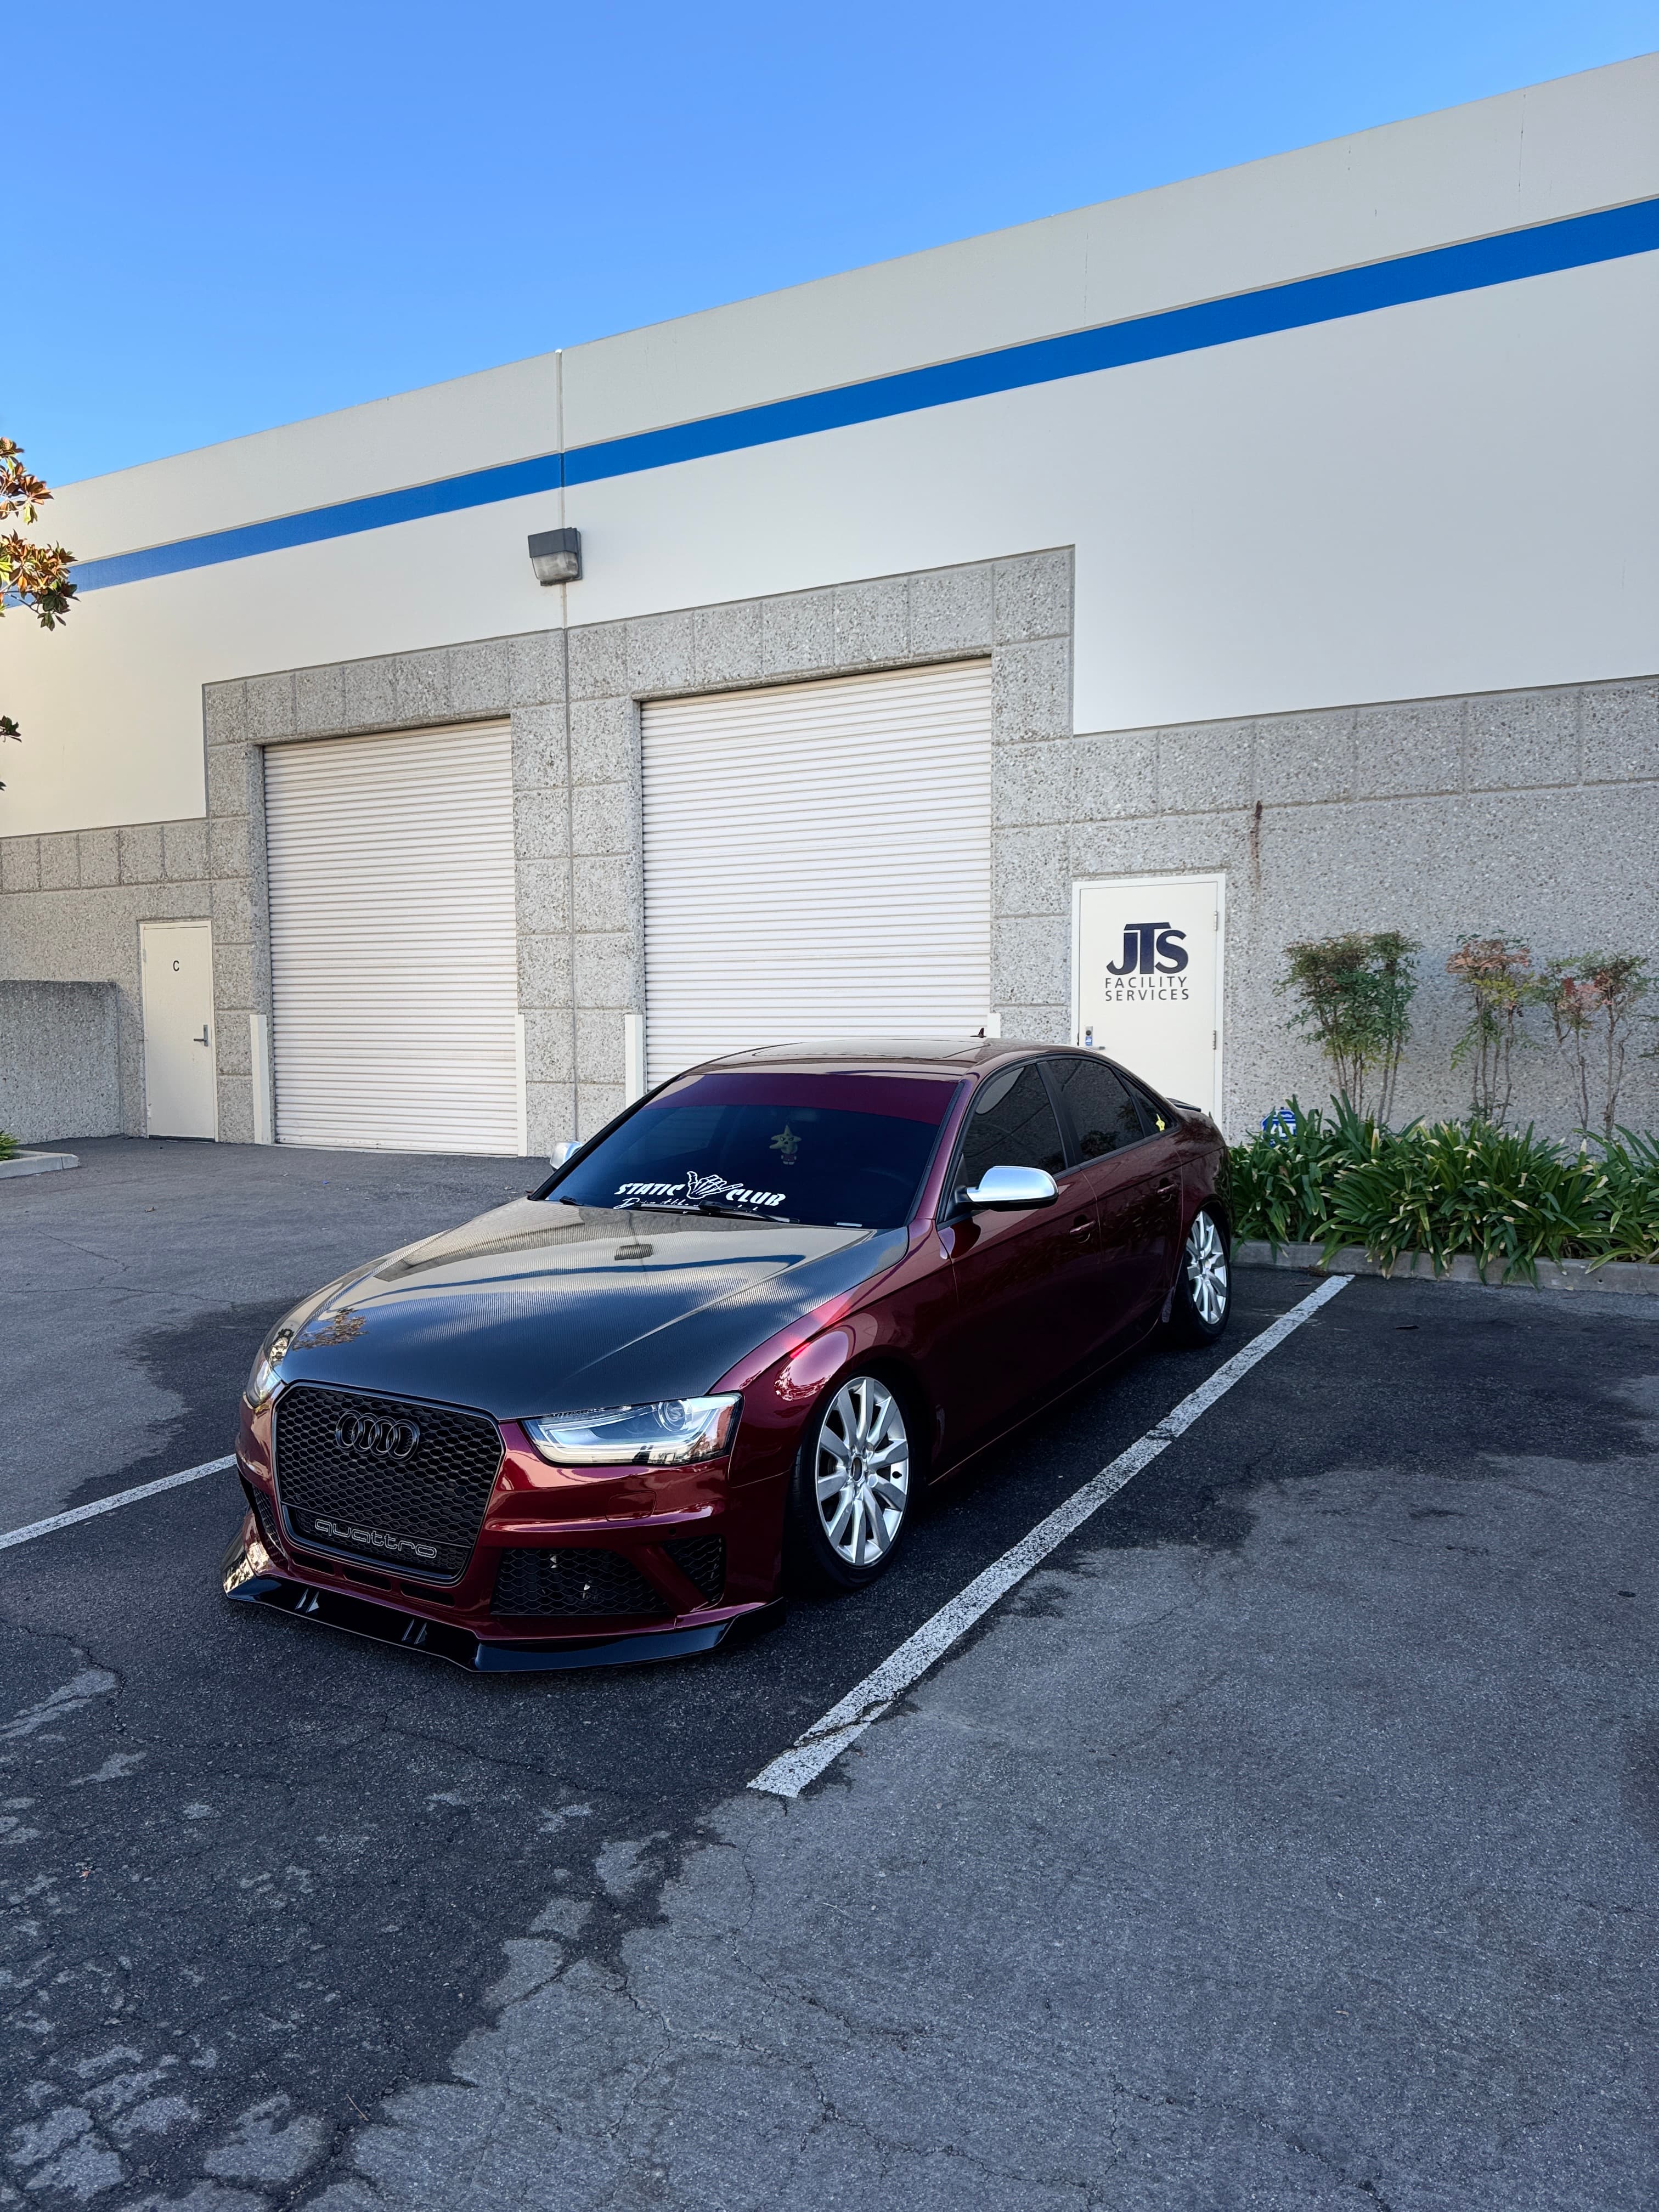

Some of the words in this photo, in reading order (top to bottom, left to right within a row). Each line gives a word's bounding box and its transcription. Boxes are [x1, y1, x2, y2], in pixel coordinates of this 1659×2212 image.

[1106, 922, 1189, 975] JTS
[173, 960, 179, 972] C
[1105, 976, 1187, 989] FACILITY
[1105, 989, 1189, 1001] SERVICES
[614, 1183, 686, 1196] STATIC
[726, 1188, 786, 1206] CLUB
[314, 1519, 437, 1559] quattro
